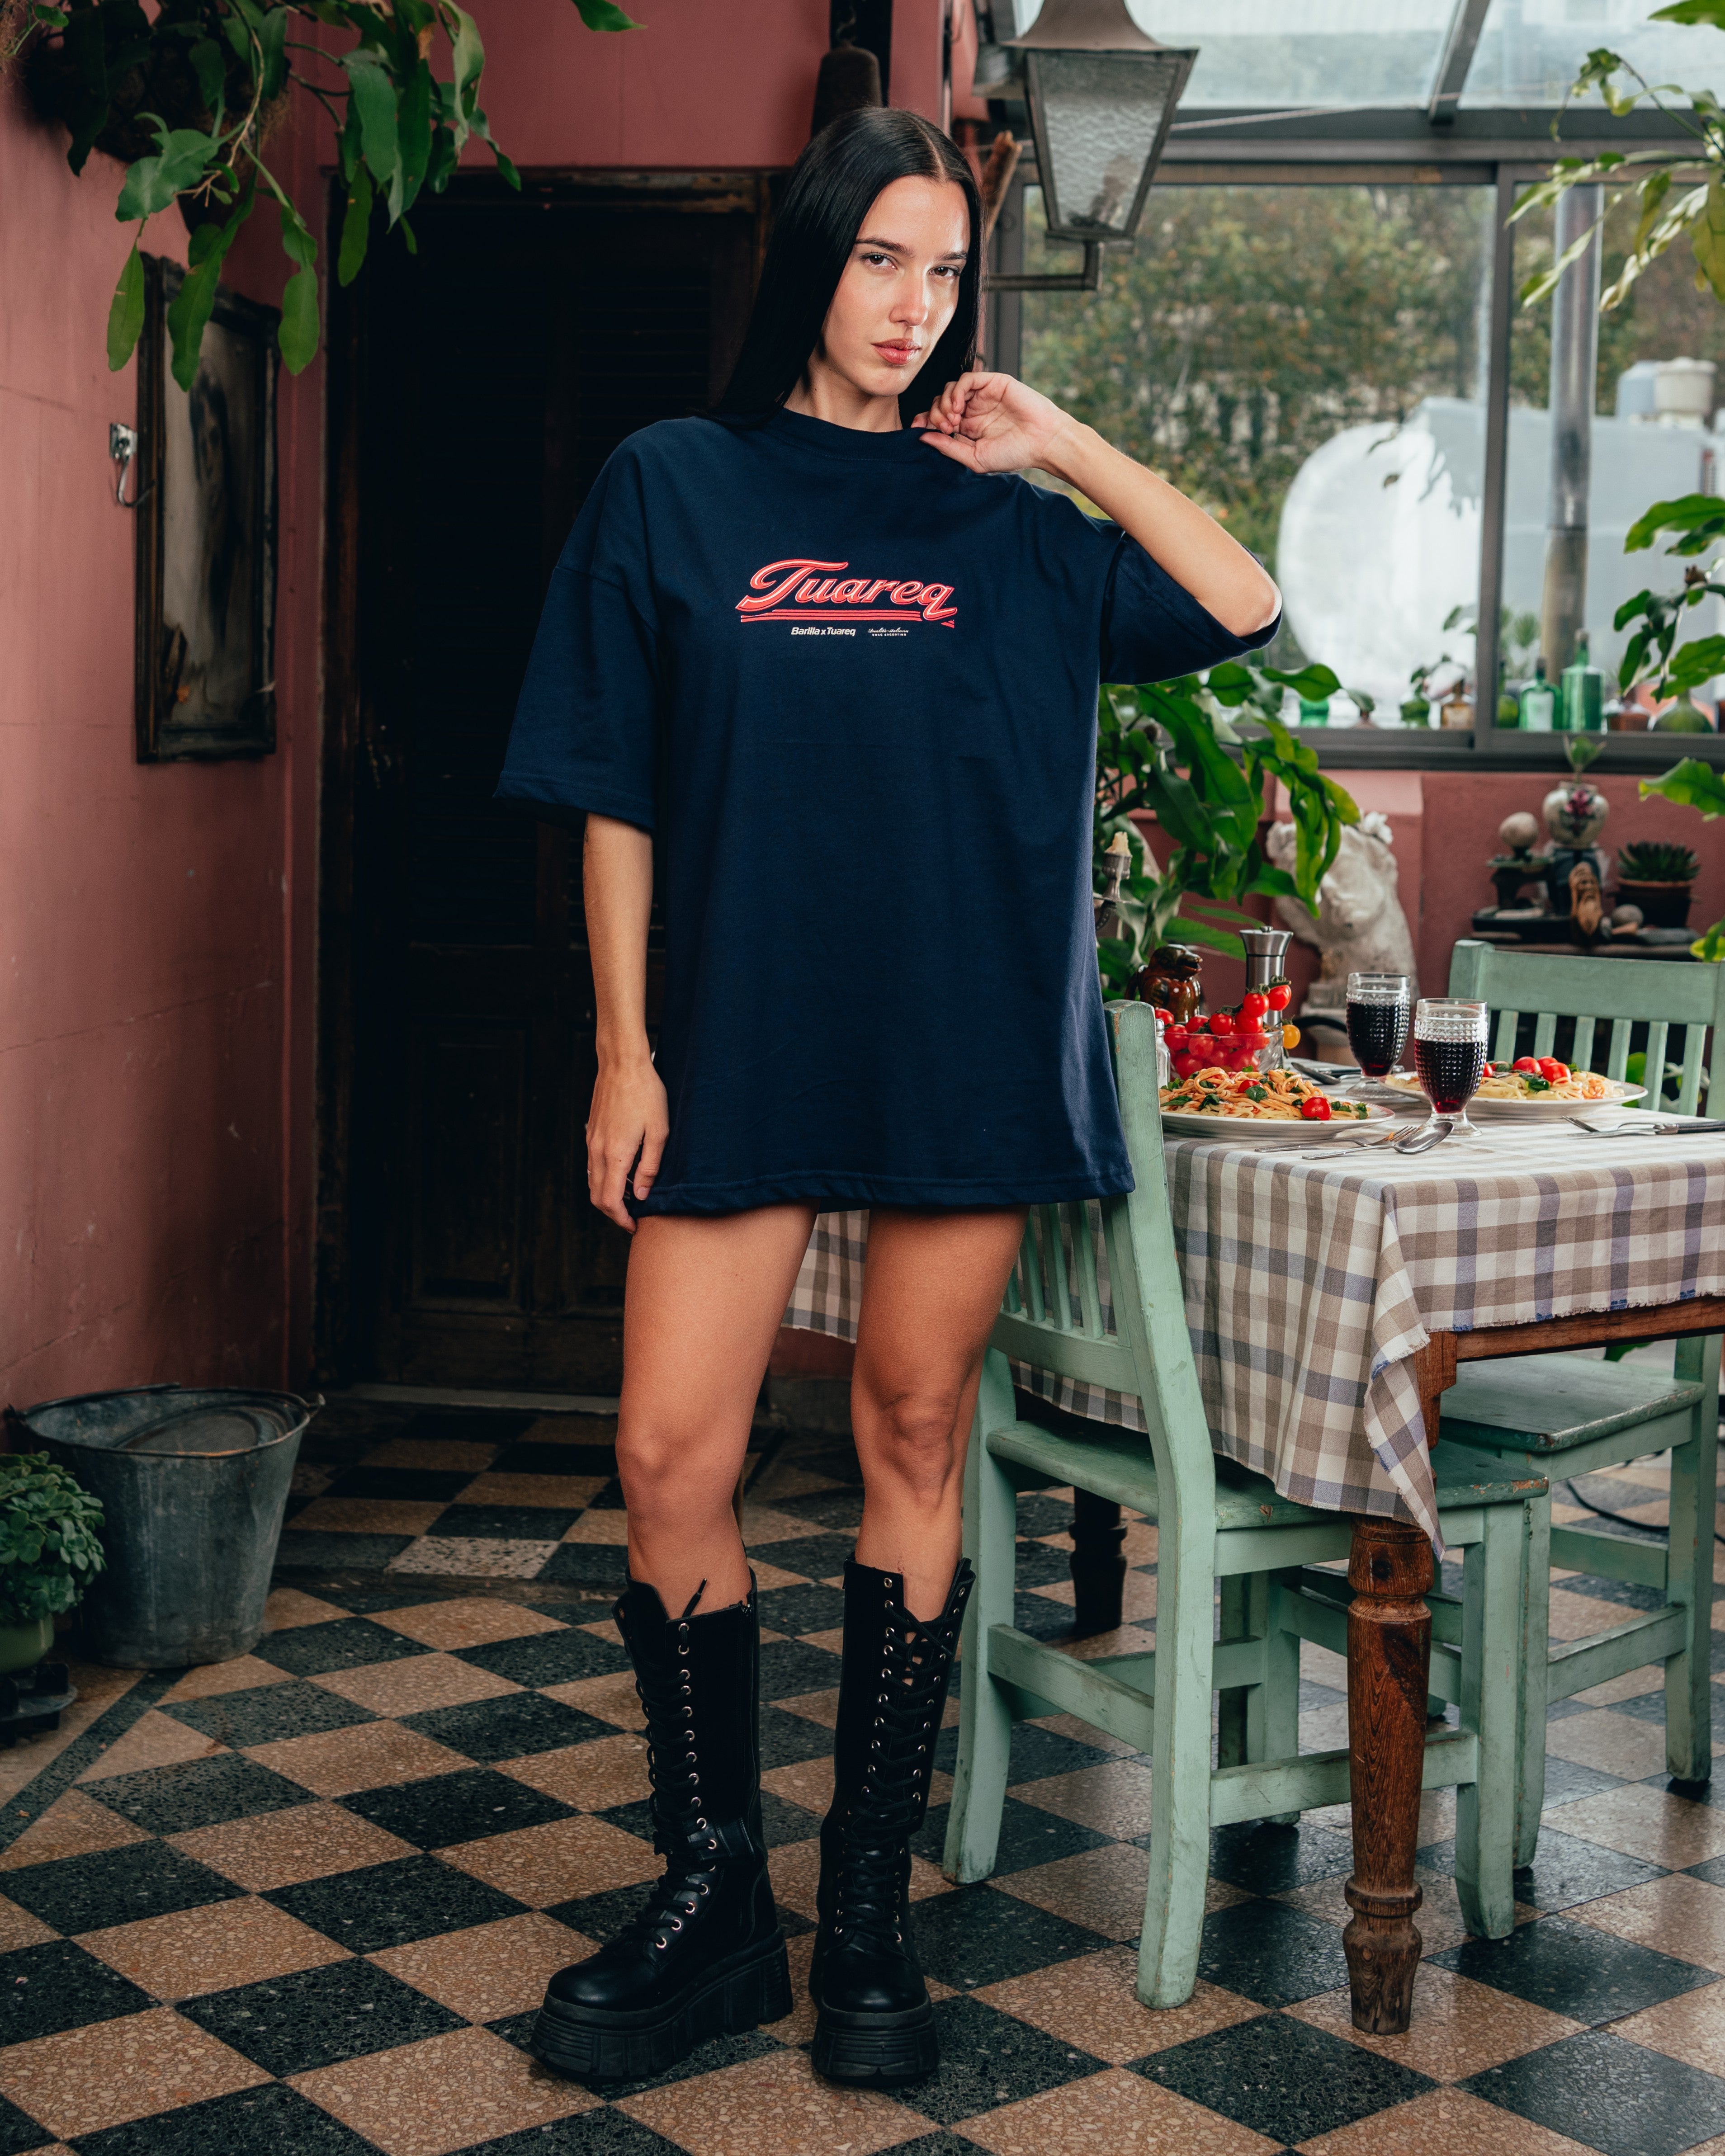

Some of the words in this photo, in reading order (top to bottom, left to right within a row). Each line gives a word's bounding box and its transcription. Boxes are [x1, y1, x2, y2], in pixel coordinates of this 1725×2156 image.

[735, 559, 957, 621] Tuareq
[791, 627, 820, 635] Barilla
[827, 627, 856, 637] Tuareq
